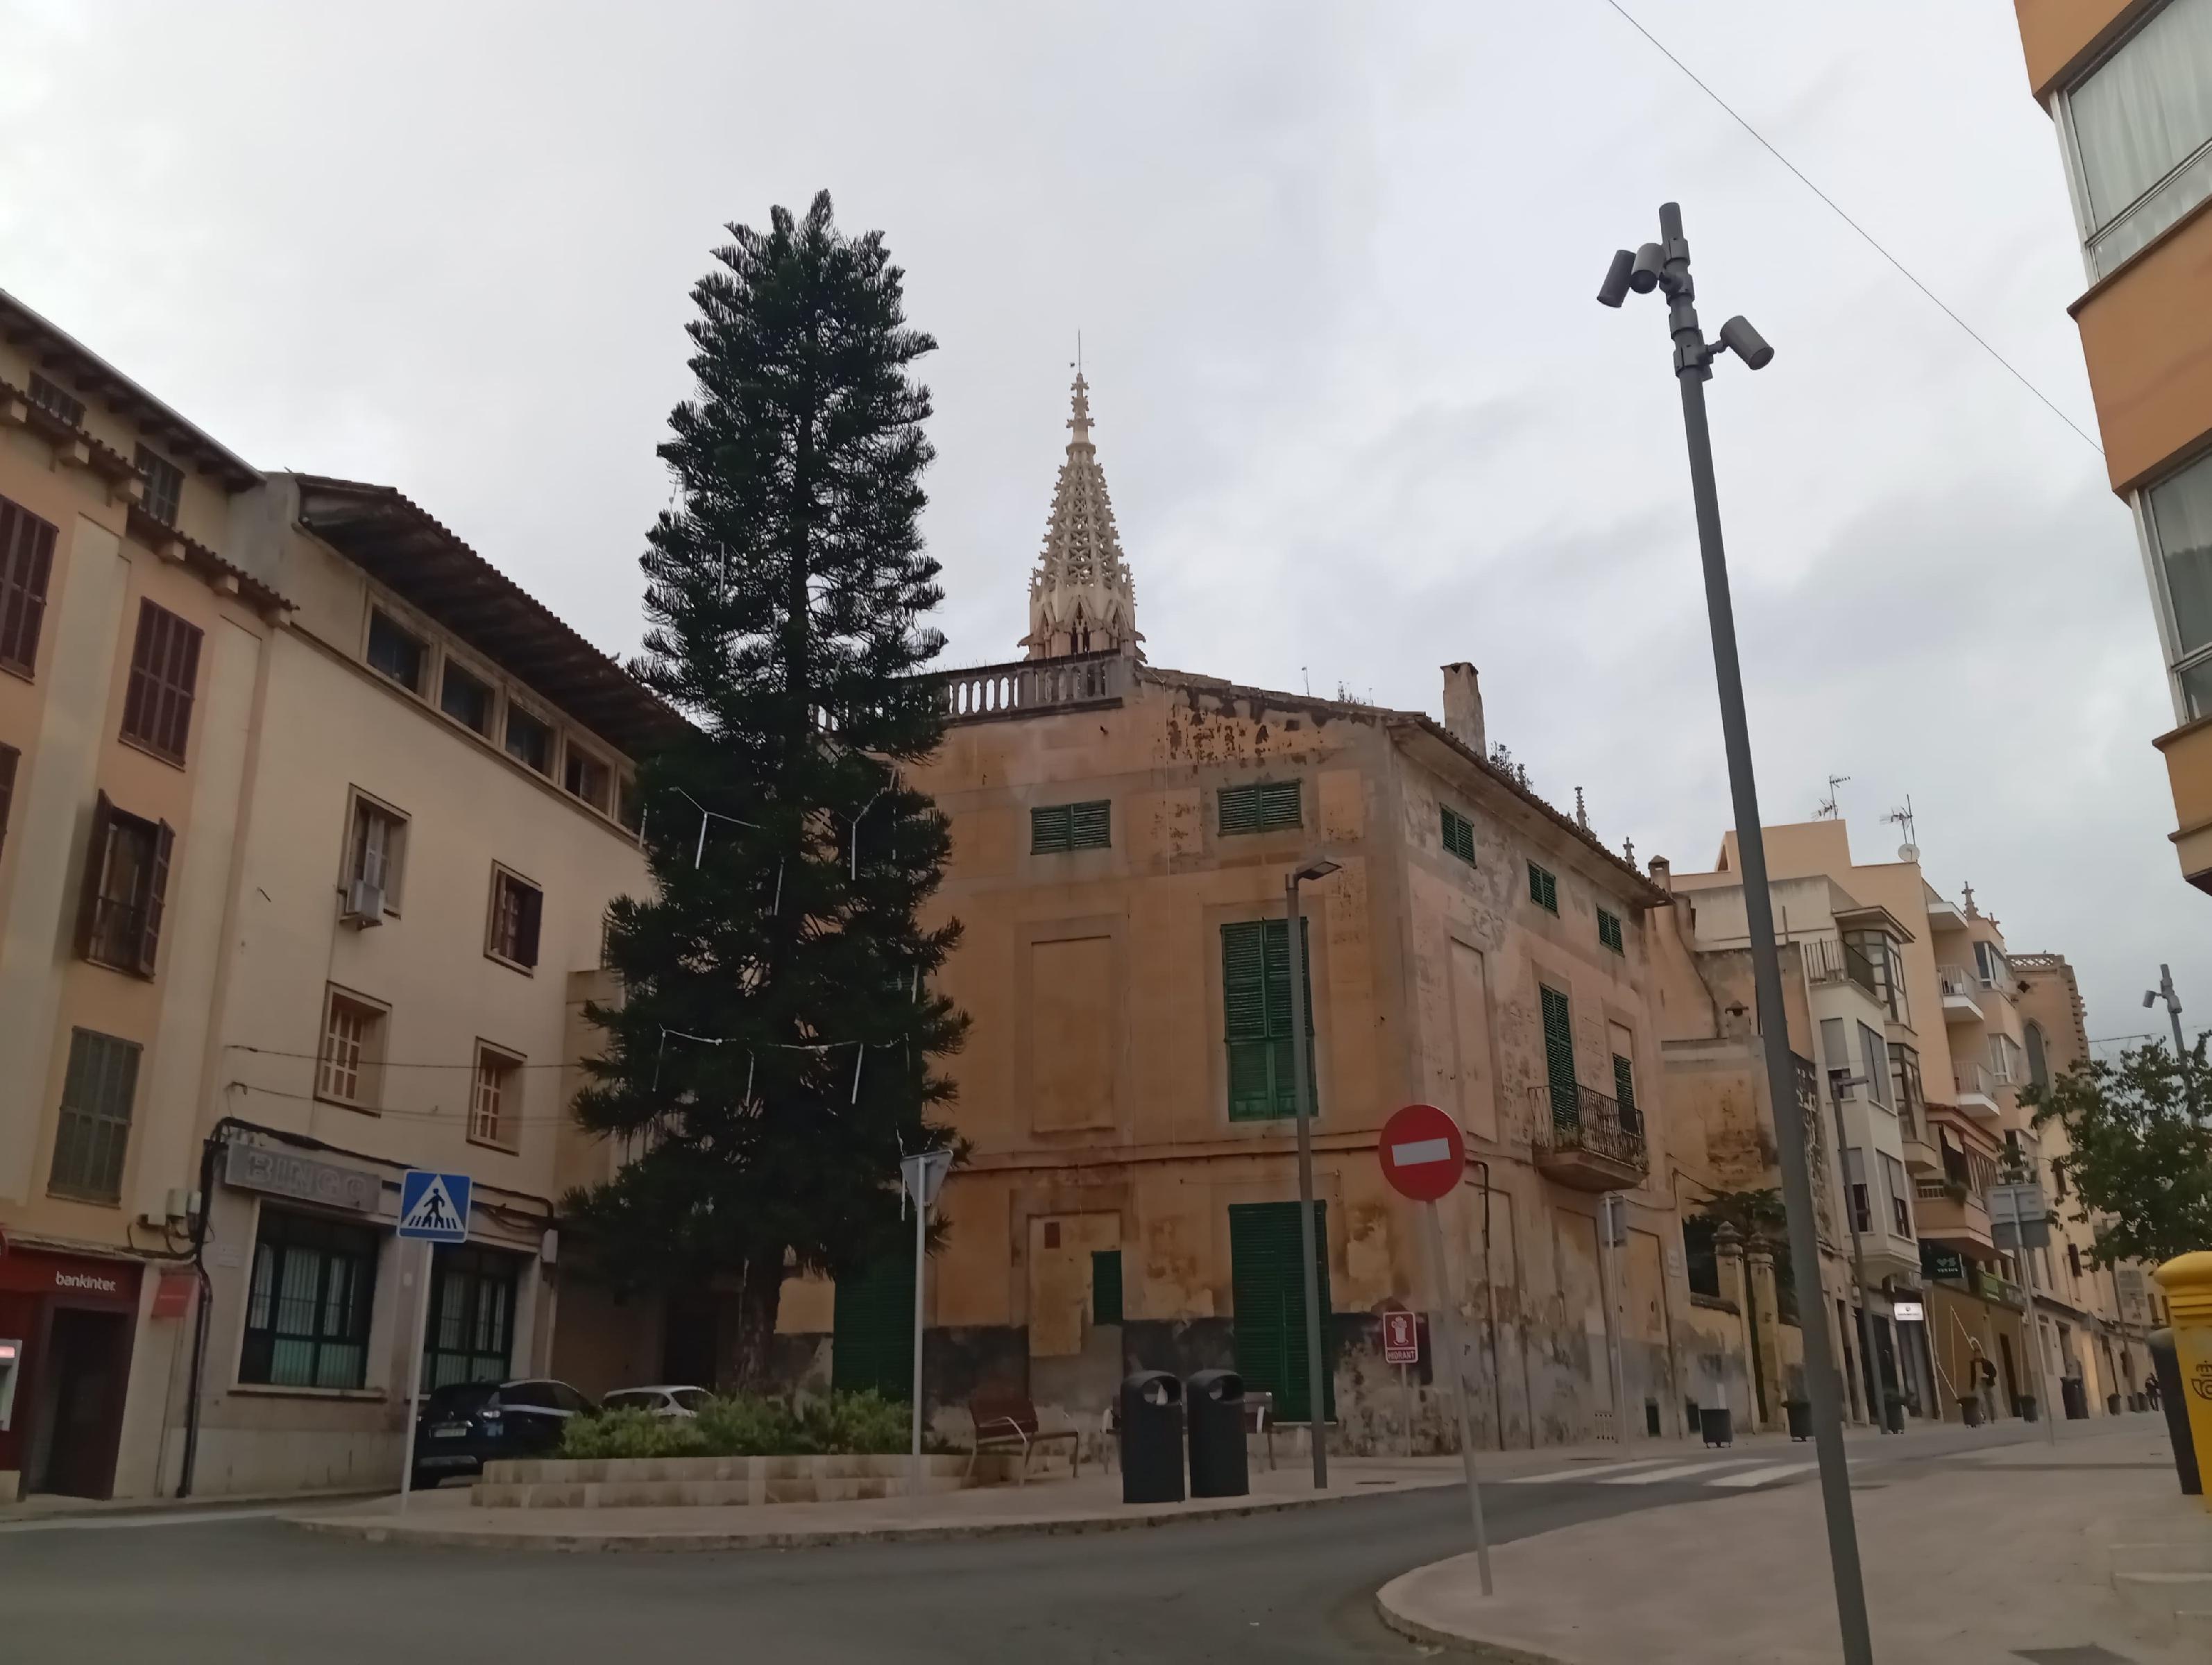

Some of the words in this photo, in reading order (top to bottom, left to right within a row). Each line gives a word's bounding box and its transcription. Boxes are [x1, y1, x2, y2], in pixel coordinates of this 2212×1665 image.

[245, 1152, 367, 1202] BINGO
[56, 1270, 116, 1292] bankinter
[1387, 1350, 1415, 1360] HIDRANT
